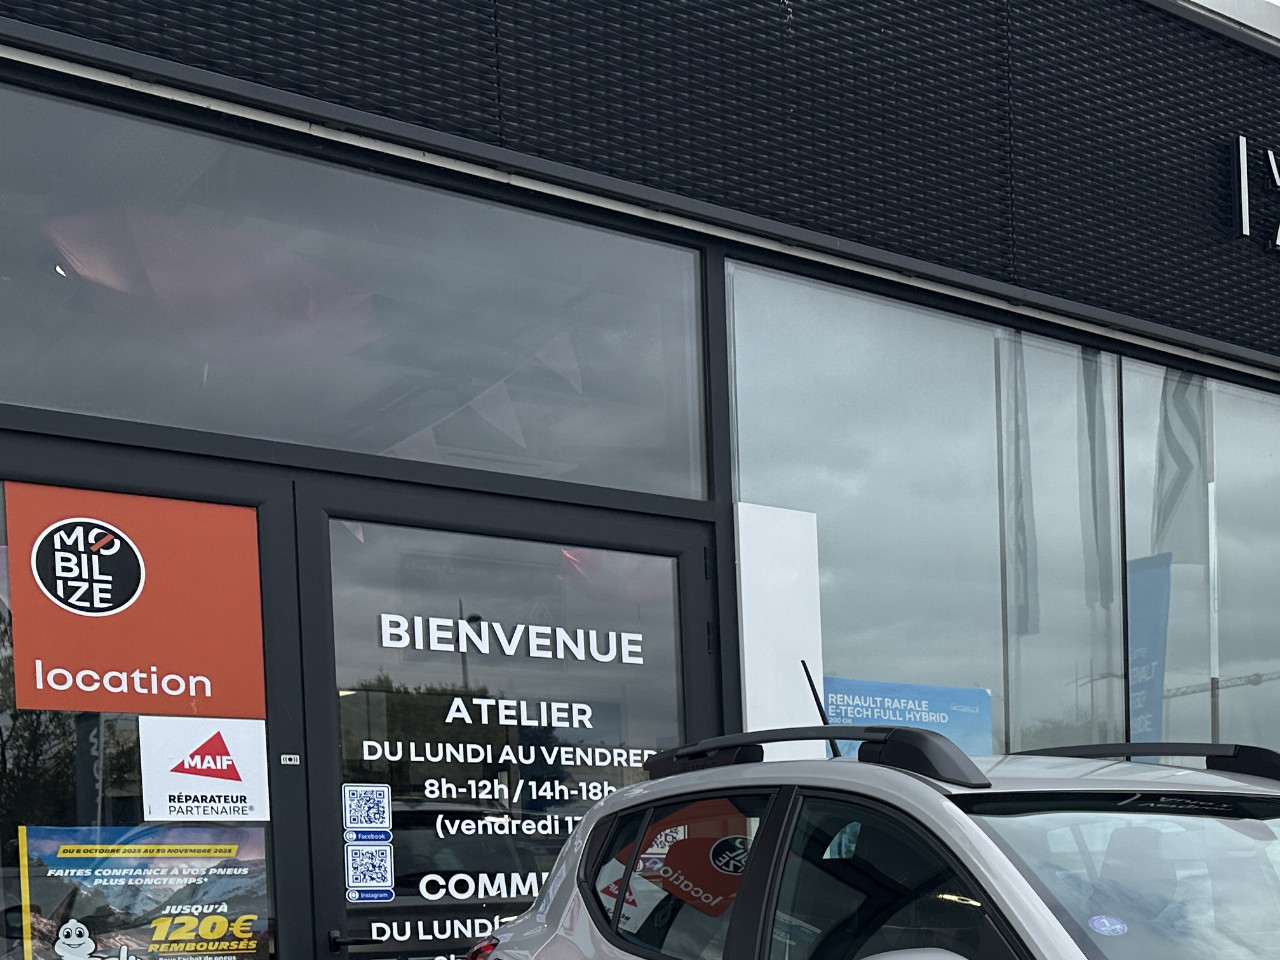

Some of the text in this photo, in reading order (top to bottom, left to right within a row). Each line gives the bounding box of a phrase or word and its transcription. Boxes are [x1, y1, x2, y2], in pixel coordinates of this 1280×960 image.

[380, 613, 645, 665] BIENVENUE
[35, 659, 213, 698] location
[828, 693, 929, 712] RENAULT RAFALE
[444, 697, 593, 729] ATELIER
[828, 705, 949, 724] E-TECH FULL HYBRID
[183, 754, 235, 771] MAIF
[362, 740, 660, 768] DU LUNDI AU VENDRE
[168, 791, 248, 805] RÉPARATEUR
[424, 779, 510, 800] 8h-12h
[436, 814, 560, 839] (vendredi
[357, 833, 386, 841] Facebook
[47, 868, 92, 877] FAITES
[94, 868, 168, 877] CONFIANCE
[182, 867, 207, 875] VOS
[208, 867, 249, 875] PNEUS
[93, 878, 126, 886] PLUS
[419, 871, 549, 901] COMM
[360, 892, 389, 900] Instagram
[161, 901, 228, 916] JUSQU'À
[149, 914, 259, 941] 120€
[371, 921, 411, 942] DU
[147, 939, 258, 952] REMBOURSÉS
